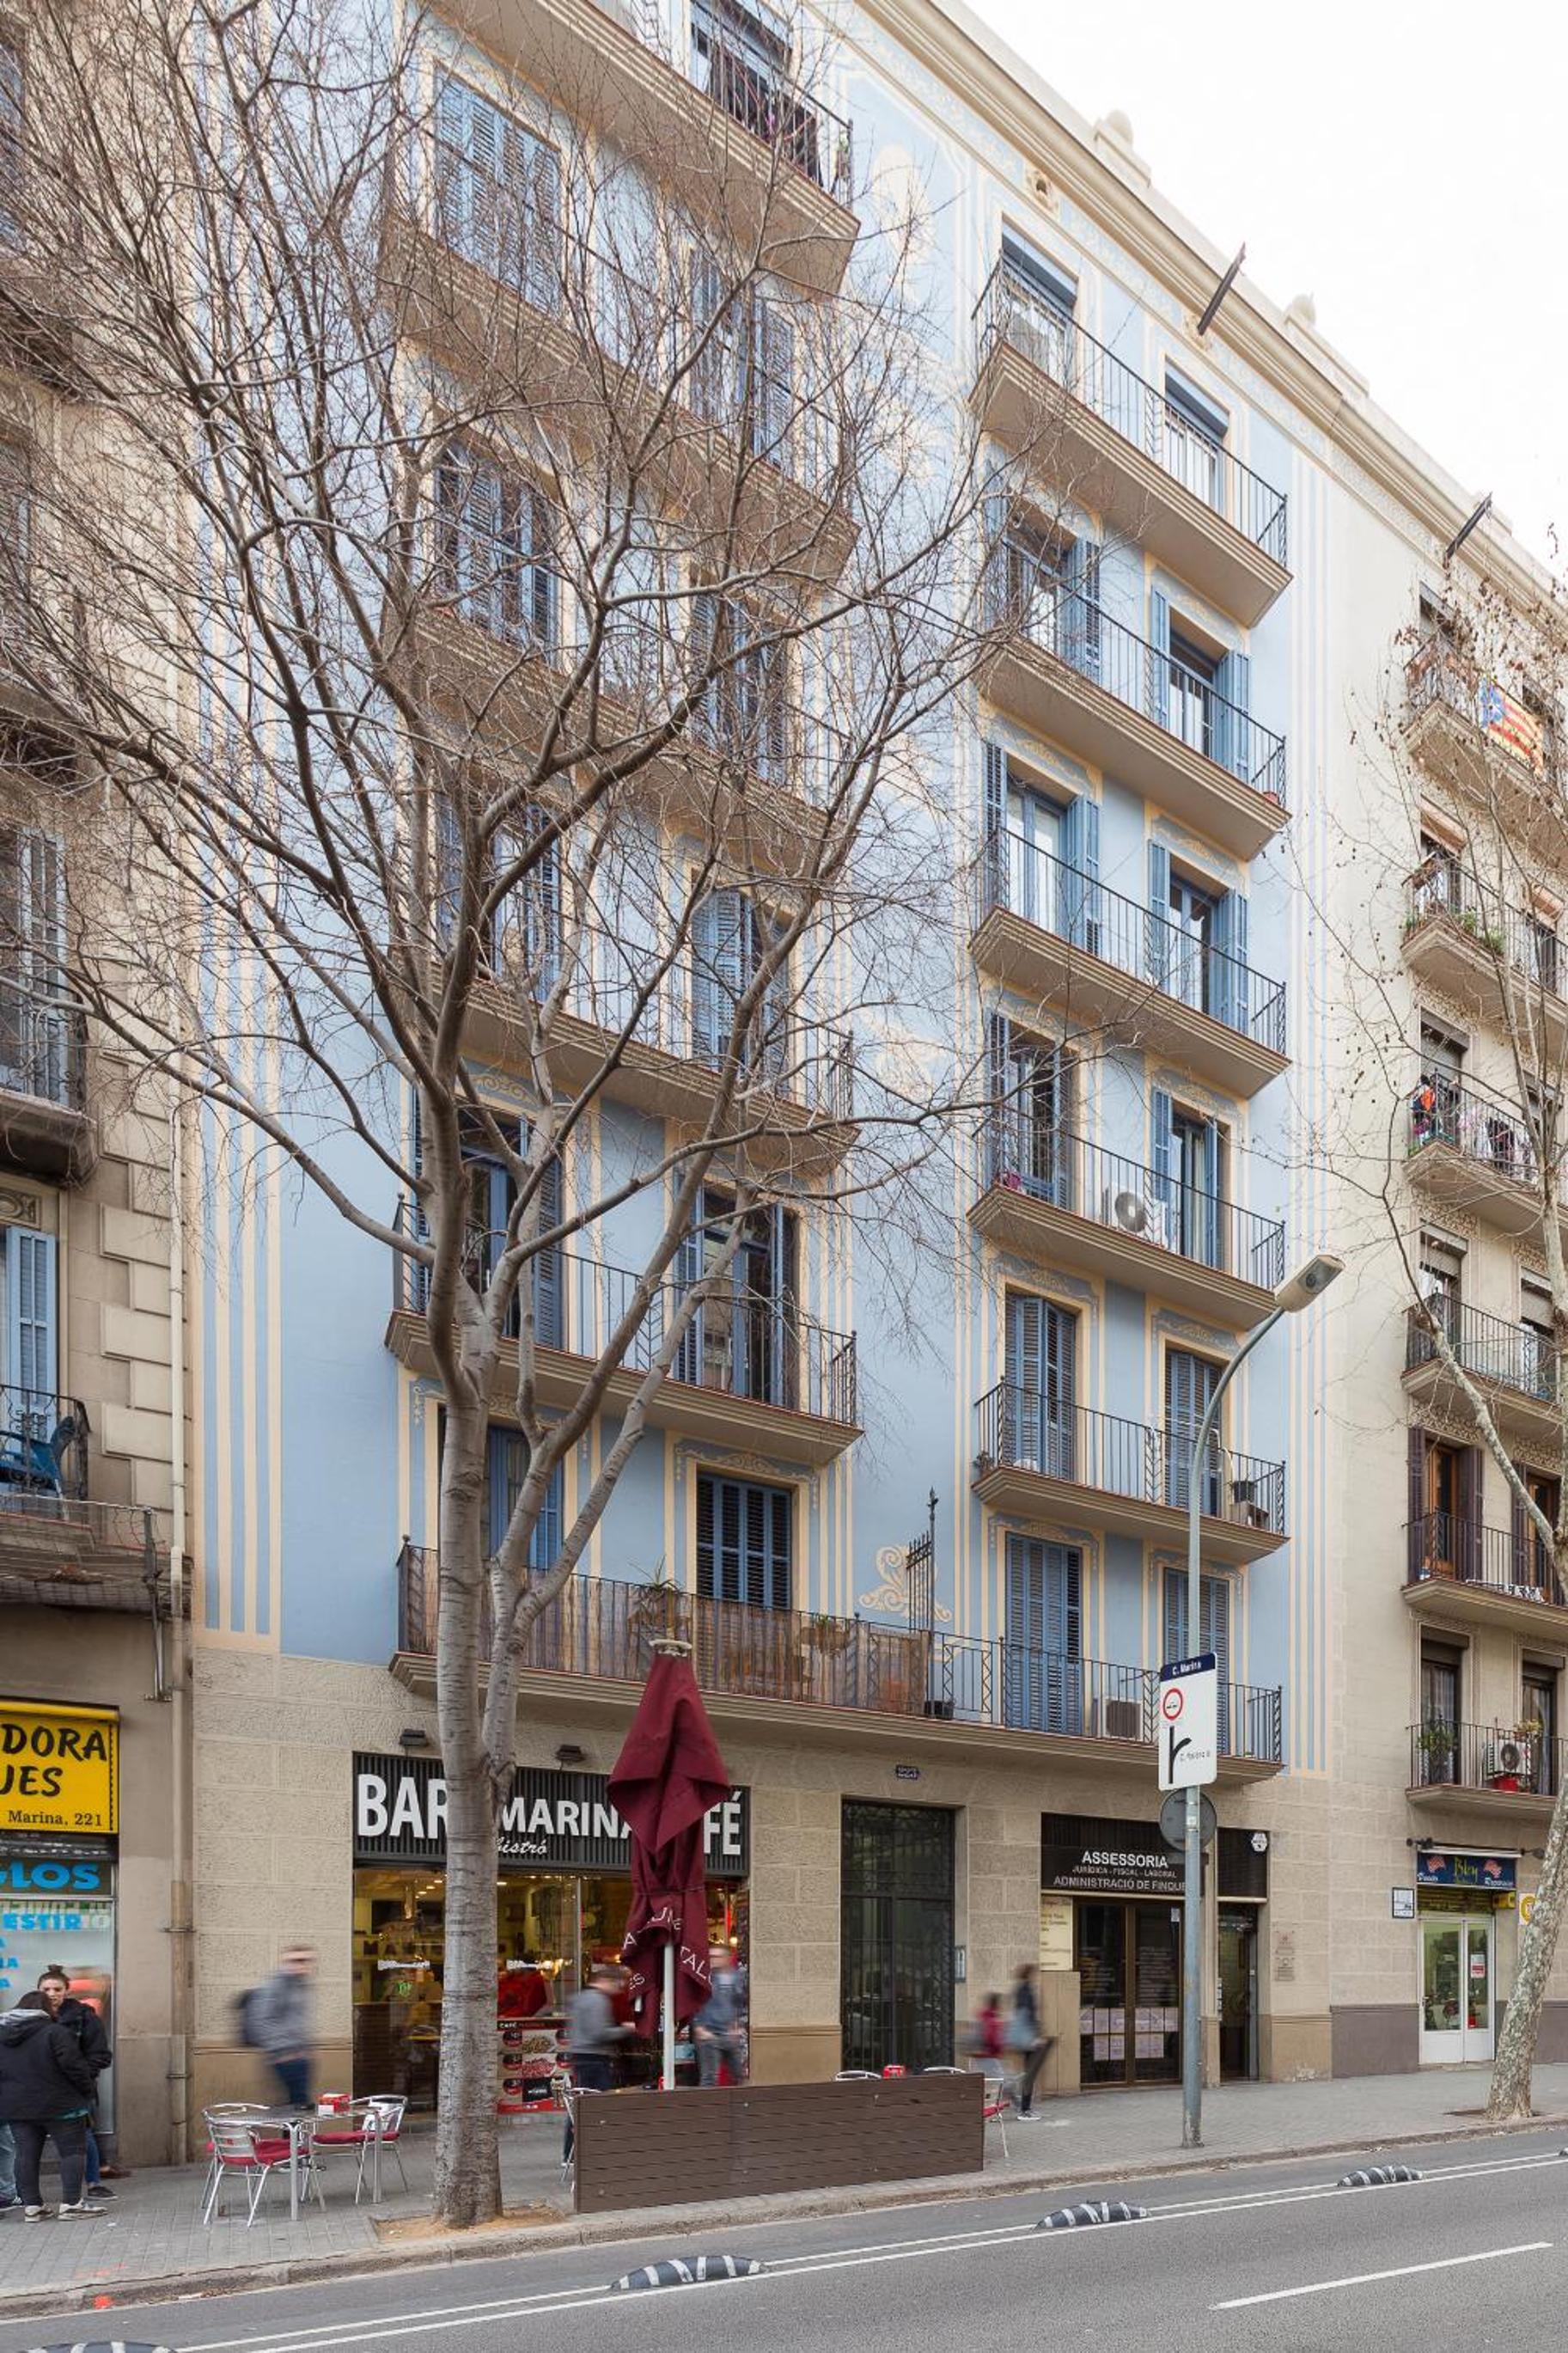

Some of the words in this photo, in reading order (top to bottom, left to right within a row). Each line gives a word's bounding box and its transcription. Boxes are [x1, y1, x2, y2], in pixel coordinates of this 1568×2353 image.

[1, 1723, 107, 1762] DORA
[357, 1774, 448, 1840] BAR
[75, 1812, 102, 1827] 221
[1082, 1850, 1169, 1868] ASSESSORIA
[0, 1861, 101, 1890] LOS
[1113, 1867, 1139, 1876] FISCAL
[1144, 1870, 1178, 1879] LABORAL
[1053, 1875, 1135, 1891] ADMINISTRACIÓ
[1136, 1879, 1150, 1890] DE
